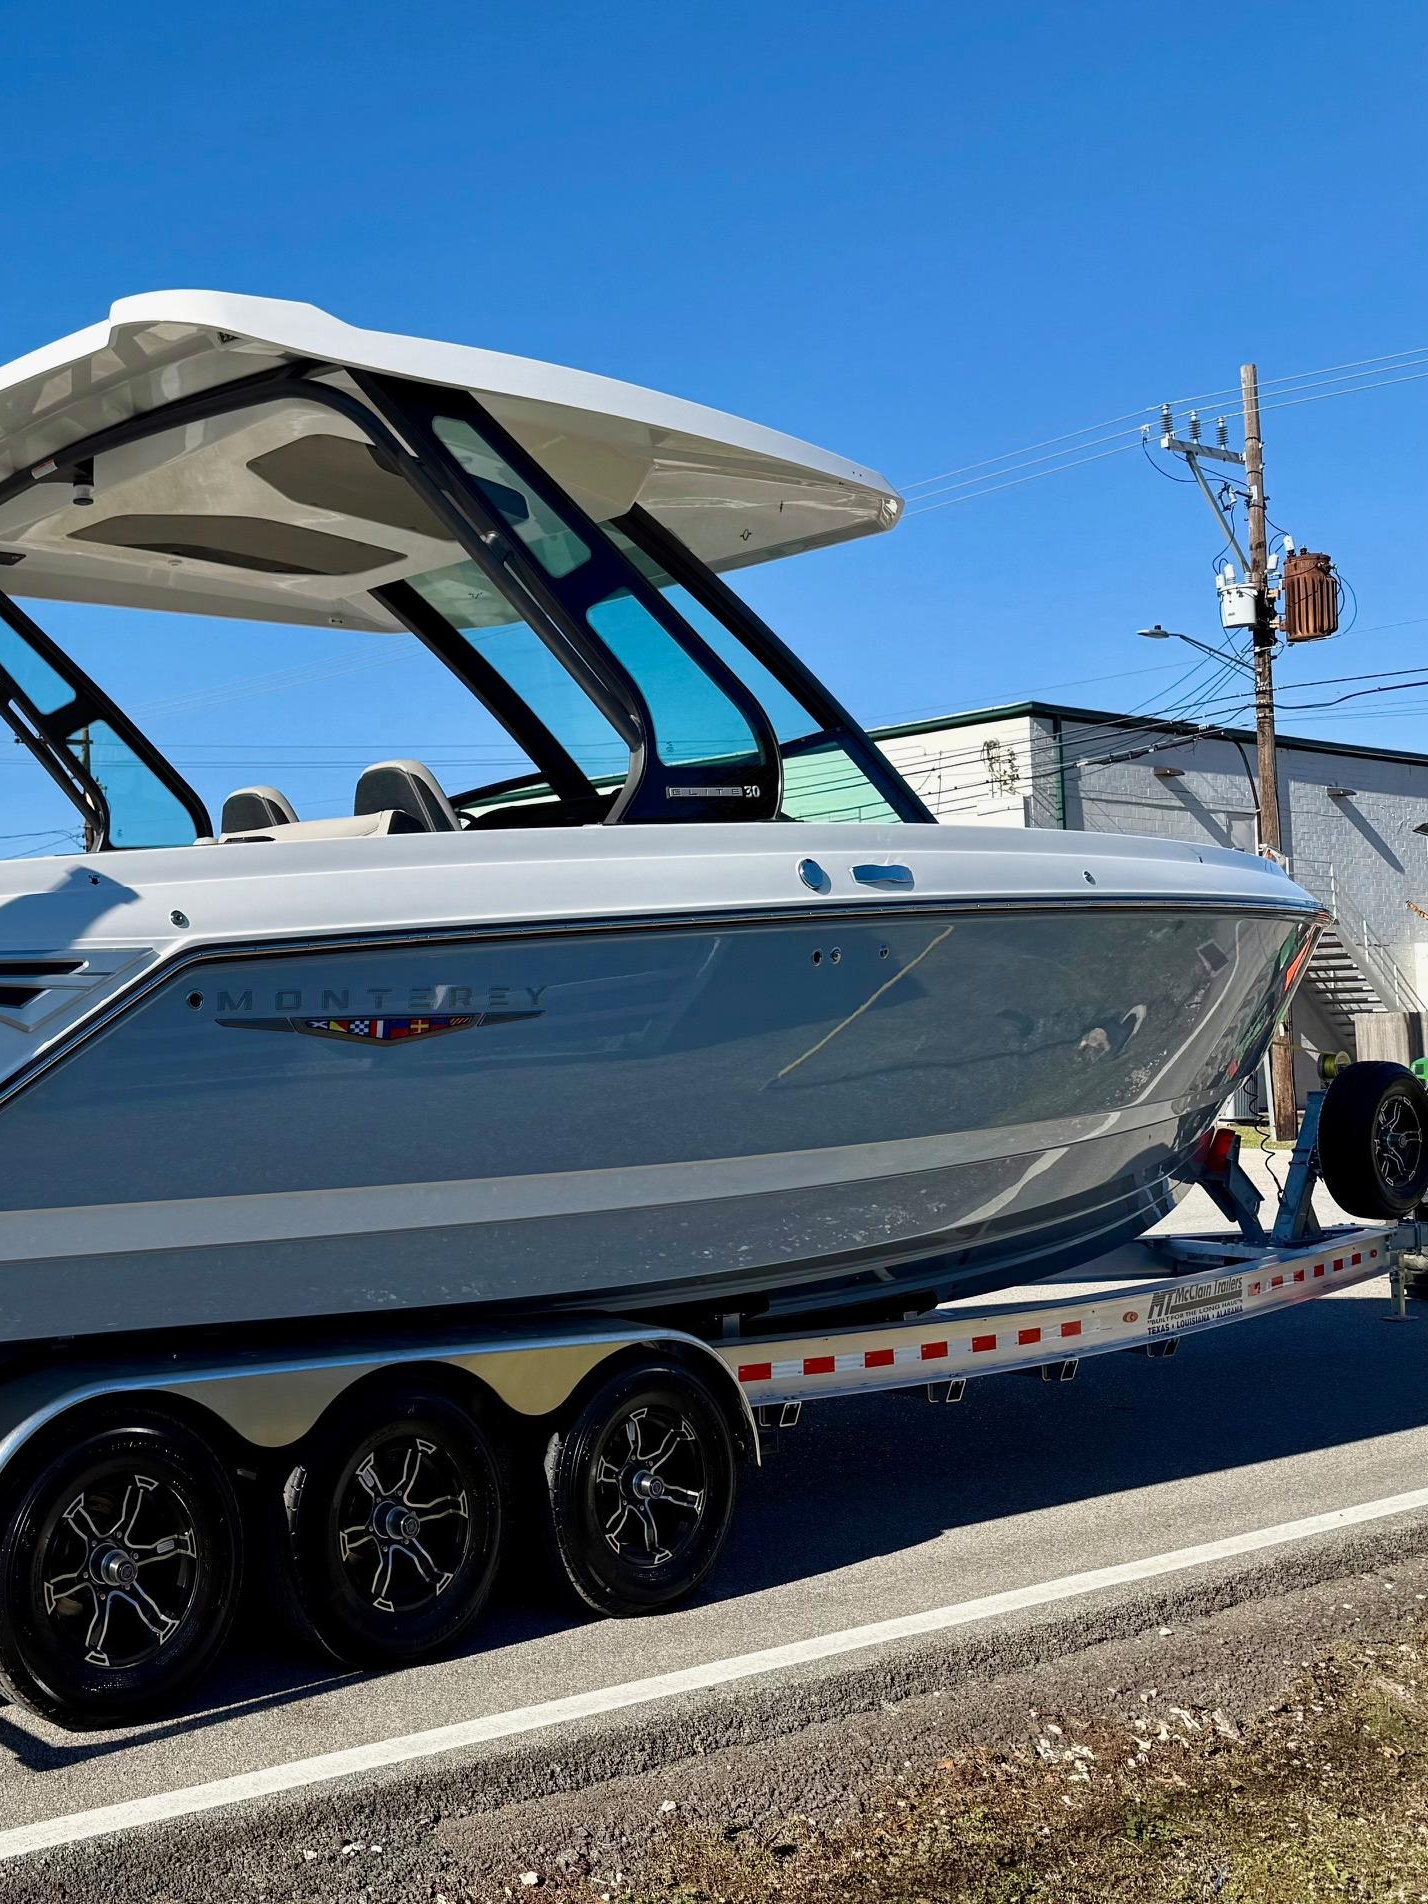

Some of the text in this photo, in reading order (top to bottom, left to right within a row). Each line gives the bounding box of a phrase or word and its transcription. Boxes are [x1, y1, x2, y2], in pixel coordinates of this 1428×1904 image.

[671, 785, 761, 798] ELITE 30
[215, 984, 548, 1012] MONTEREY
[1174, 1277, 1243, 1304] McClain Trailers
[1199, 1303, 1220, 1314] LONG
[1147, 1324, 1170, 1335] TEXAS
[1176, 1314, 1211, 1328] LOUISIANA
